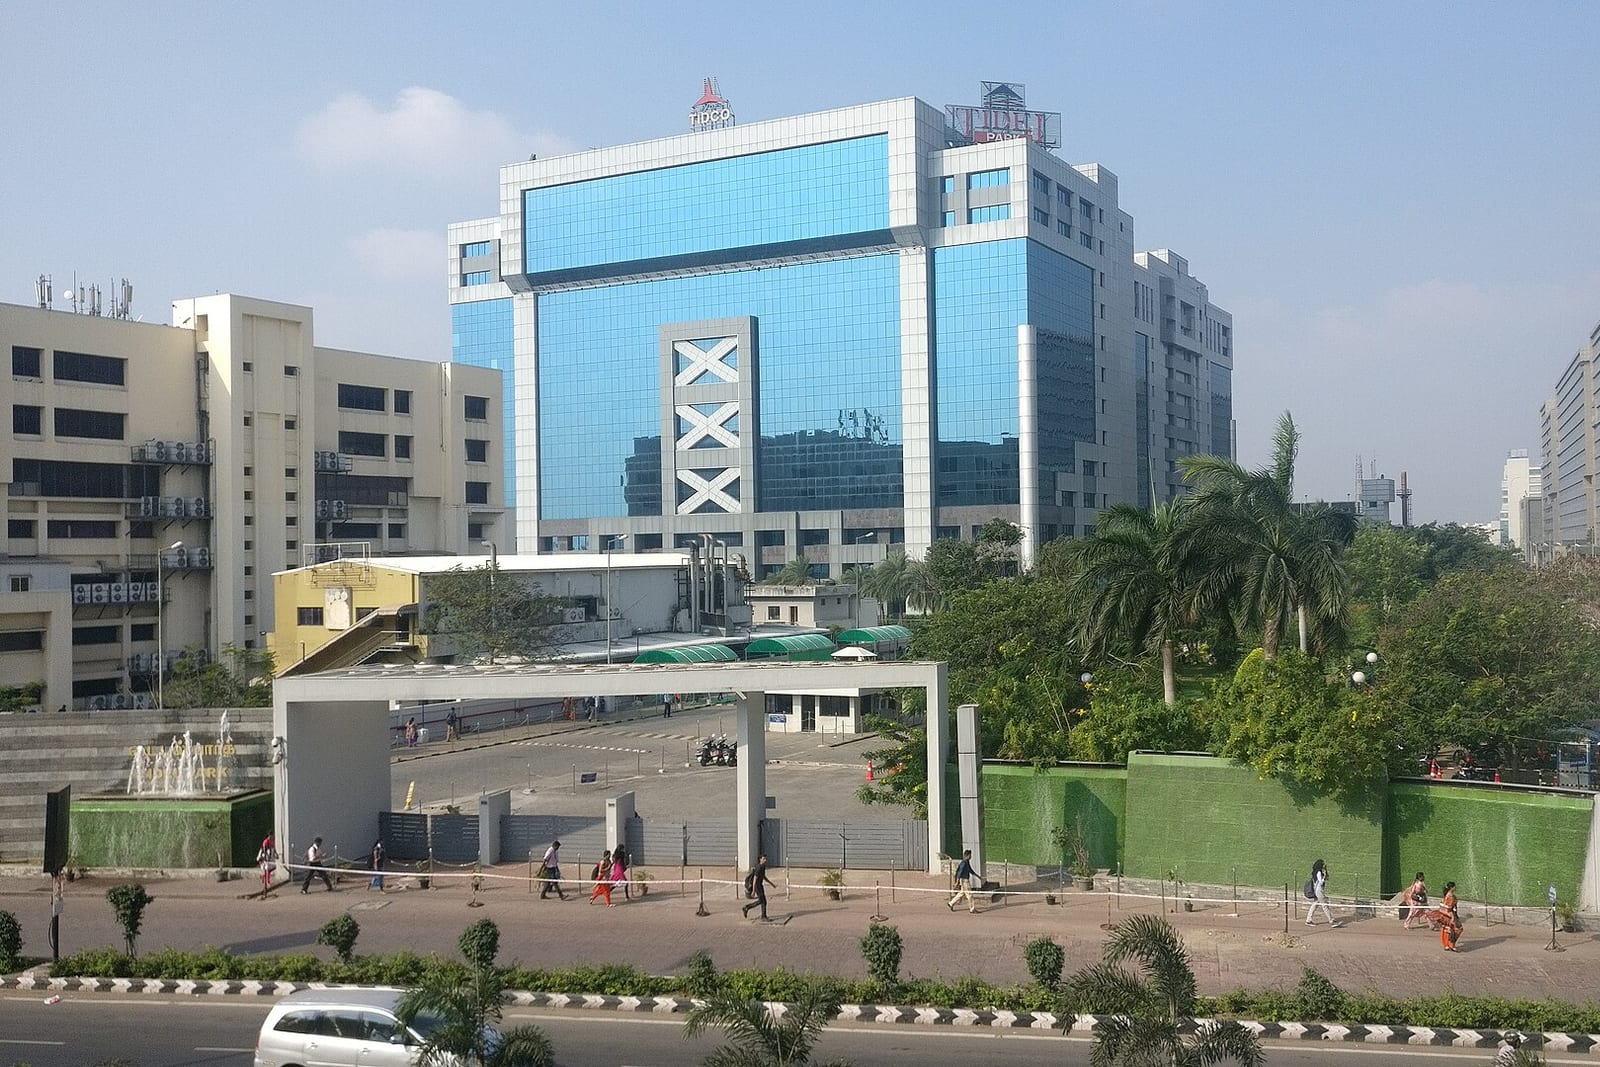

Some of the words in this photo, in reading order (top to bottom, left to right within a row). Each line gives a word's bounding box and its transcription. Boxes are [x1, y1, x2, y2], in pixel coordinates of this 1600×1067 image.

[689, 108, 730, 125] TIDCO
[955, 107, 1056, 144] TIDEL
[188, 767, 229, 778] ARK
